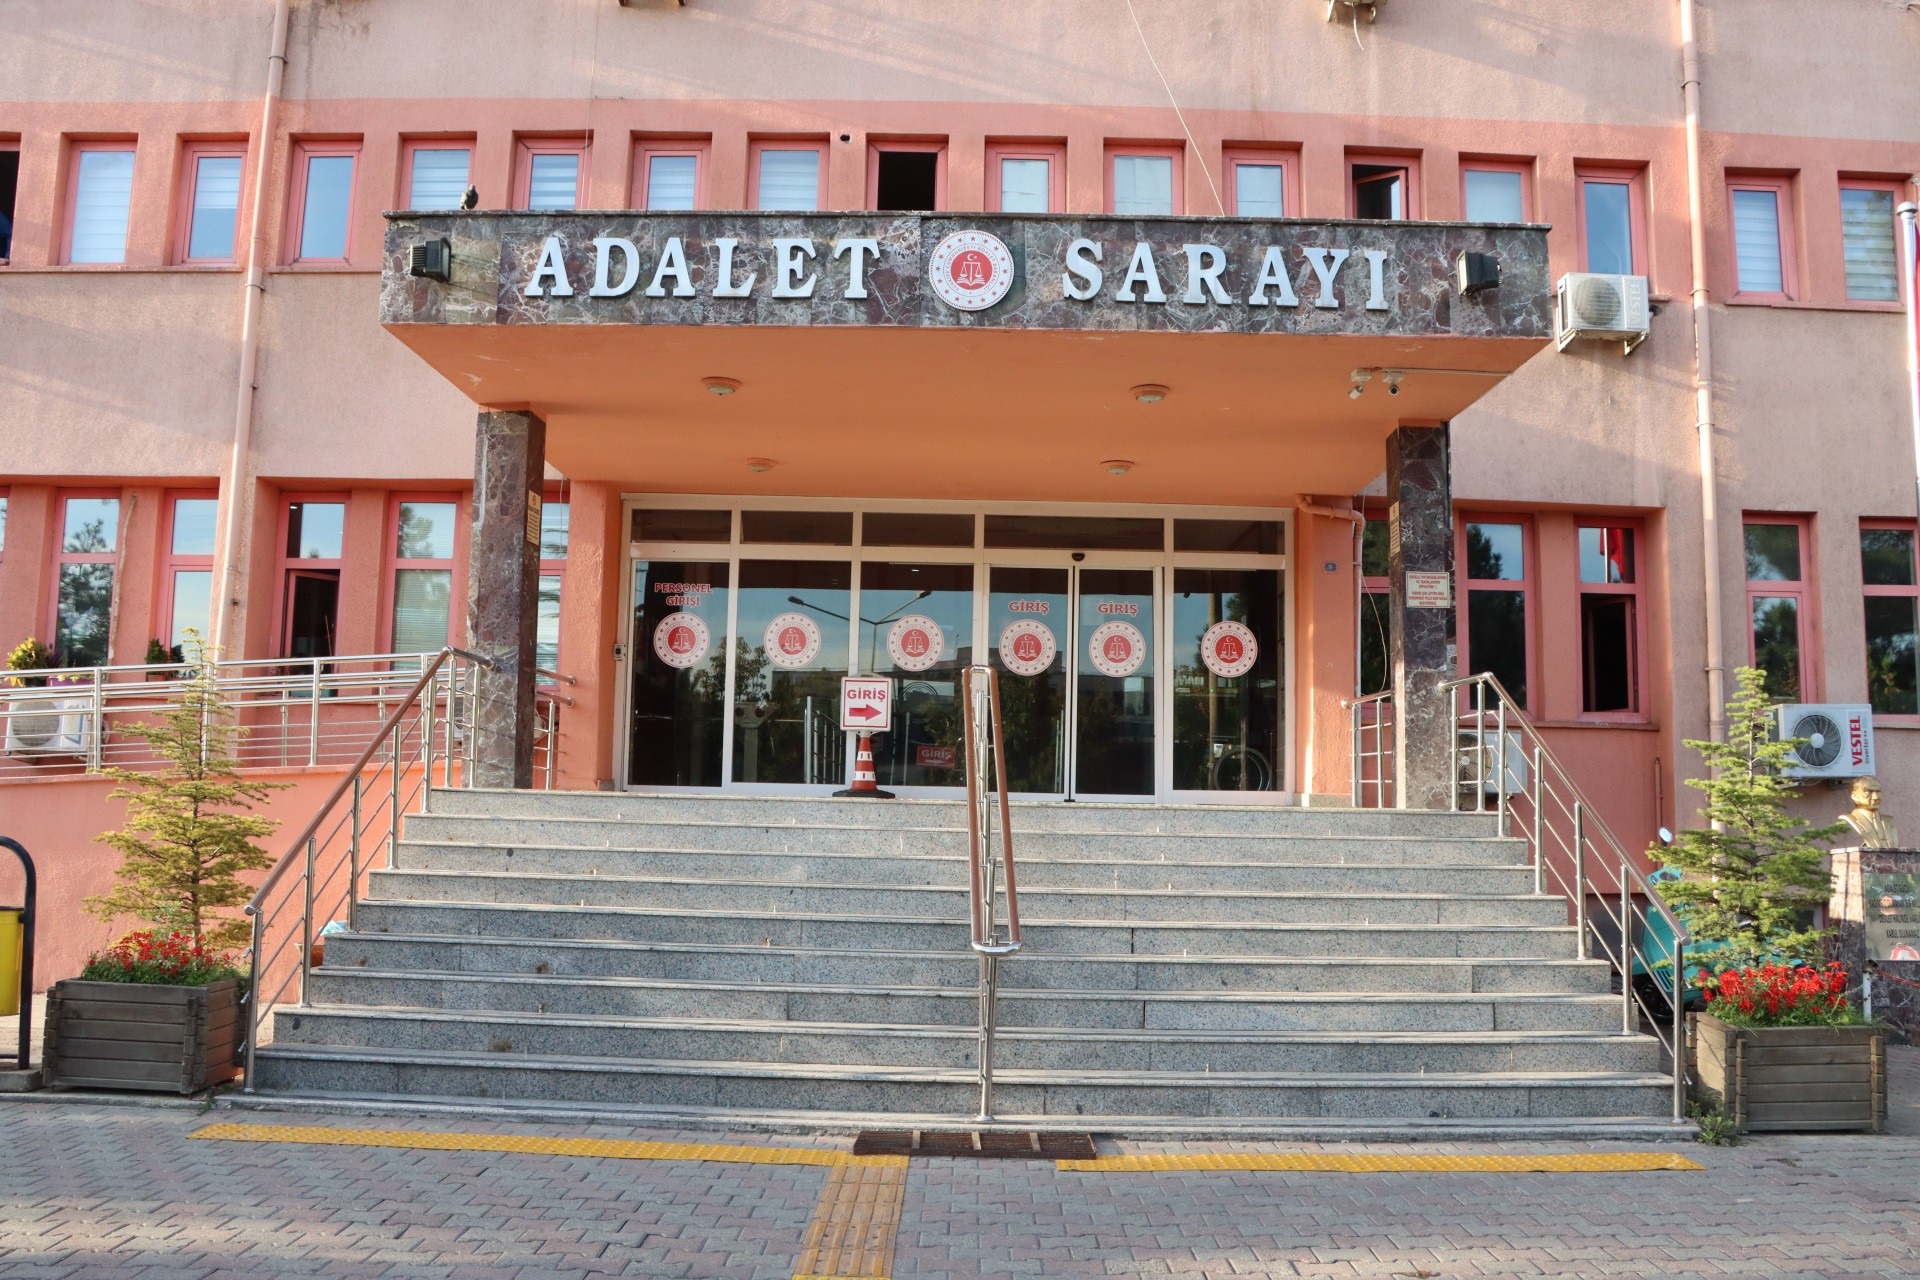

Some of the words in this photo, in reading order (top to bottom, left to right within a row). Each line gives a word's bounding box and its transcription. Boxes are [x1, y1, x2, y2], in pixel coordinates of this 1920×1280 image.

[524, 237, 881, 299] ADALET
[1062, 238, 1389, 310] SARAYI
[1630, 281, 1641, 325] VESTEL
[654, 583, 713, 593] PERSONEL
[1008, 599, 1049, 615] GİRİŞ
[1097, 602, 1138, 617] GİRİŞ
[847, 687, 886, 702] GİRİŞ
[1850, 715, 1862, 766] VESTEL
[921, 749, 952, 759] GİRİŞ
